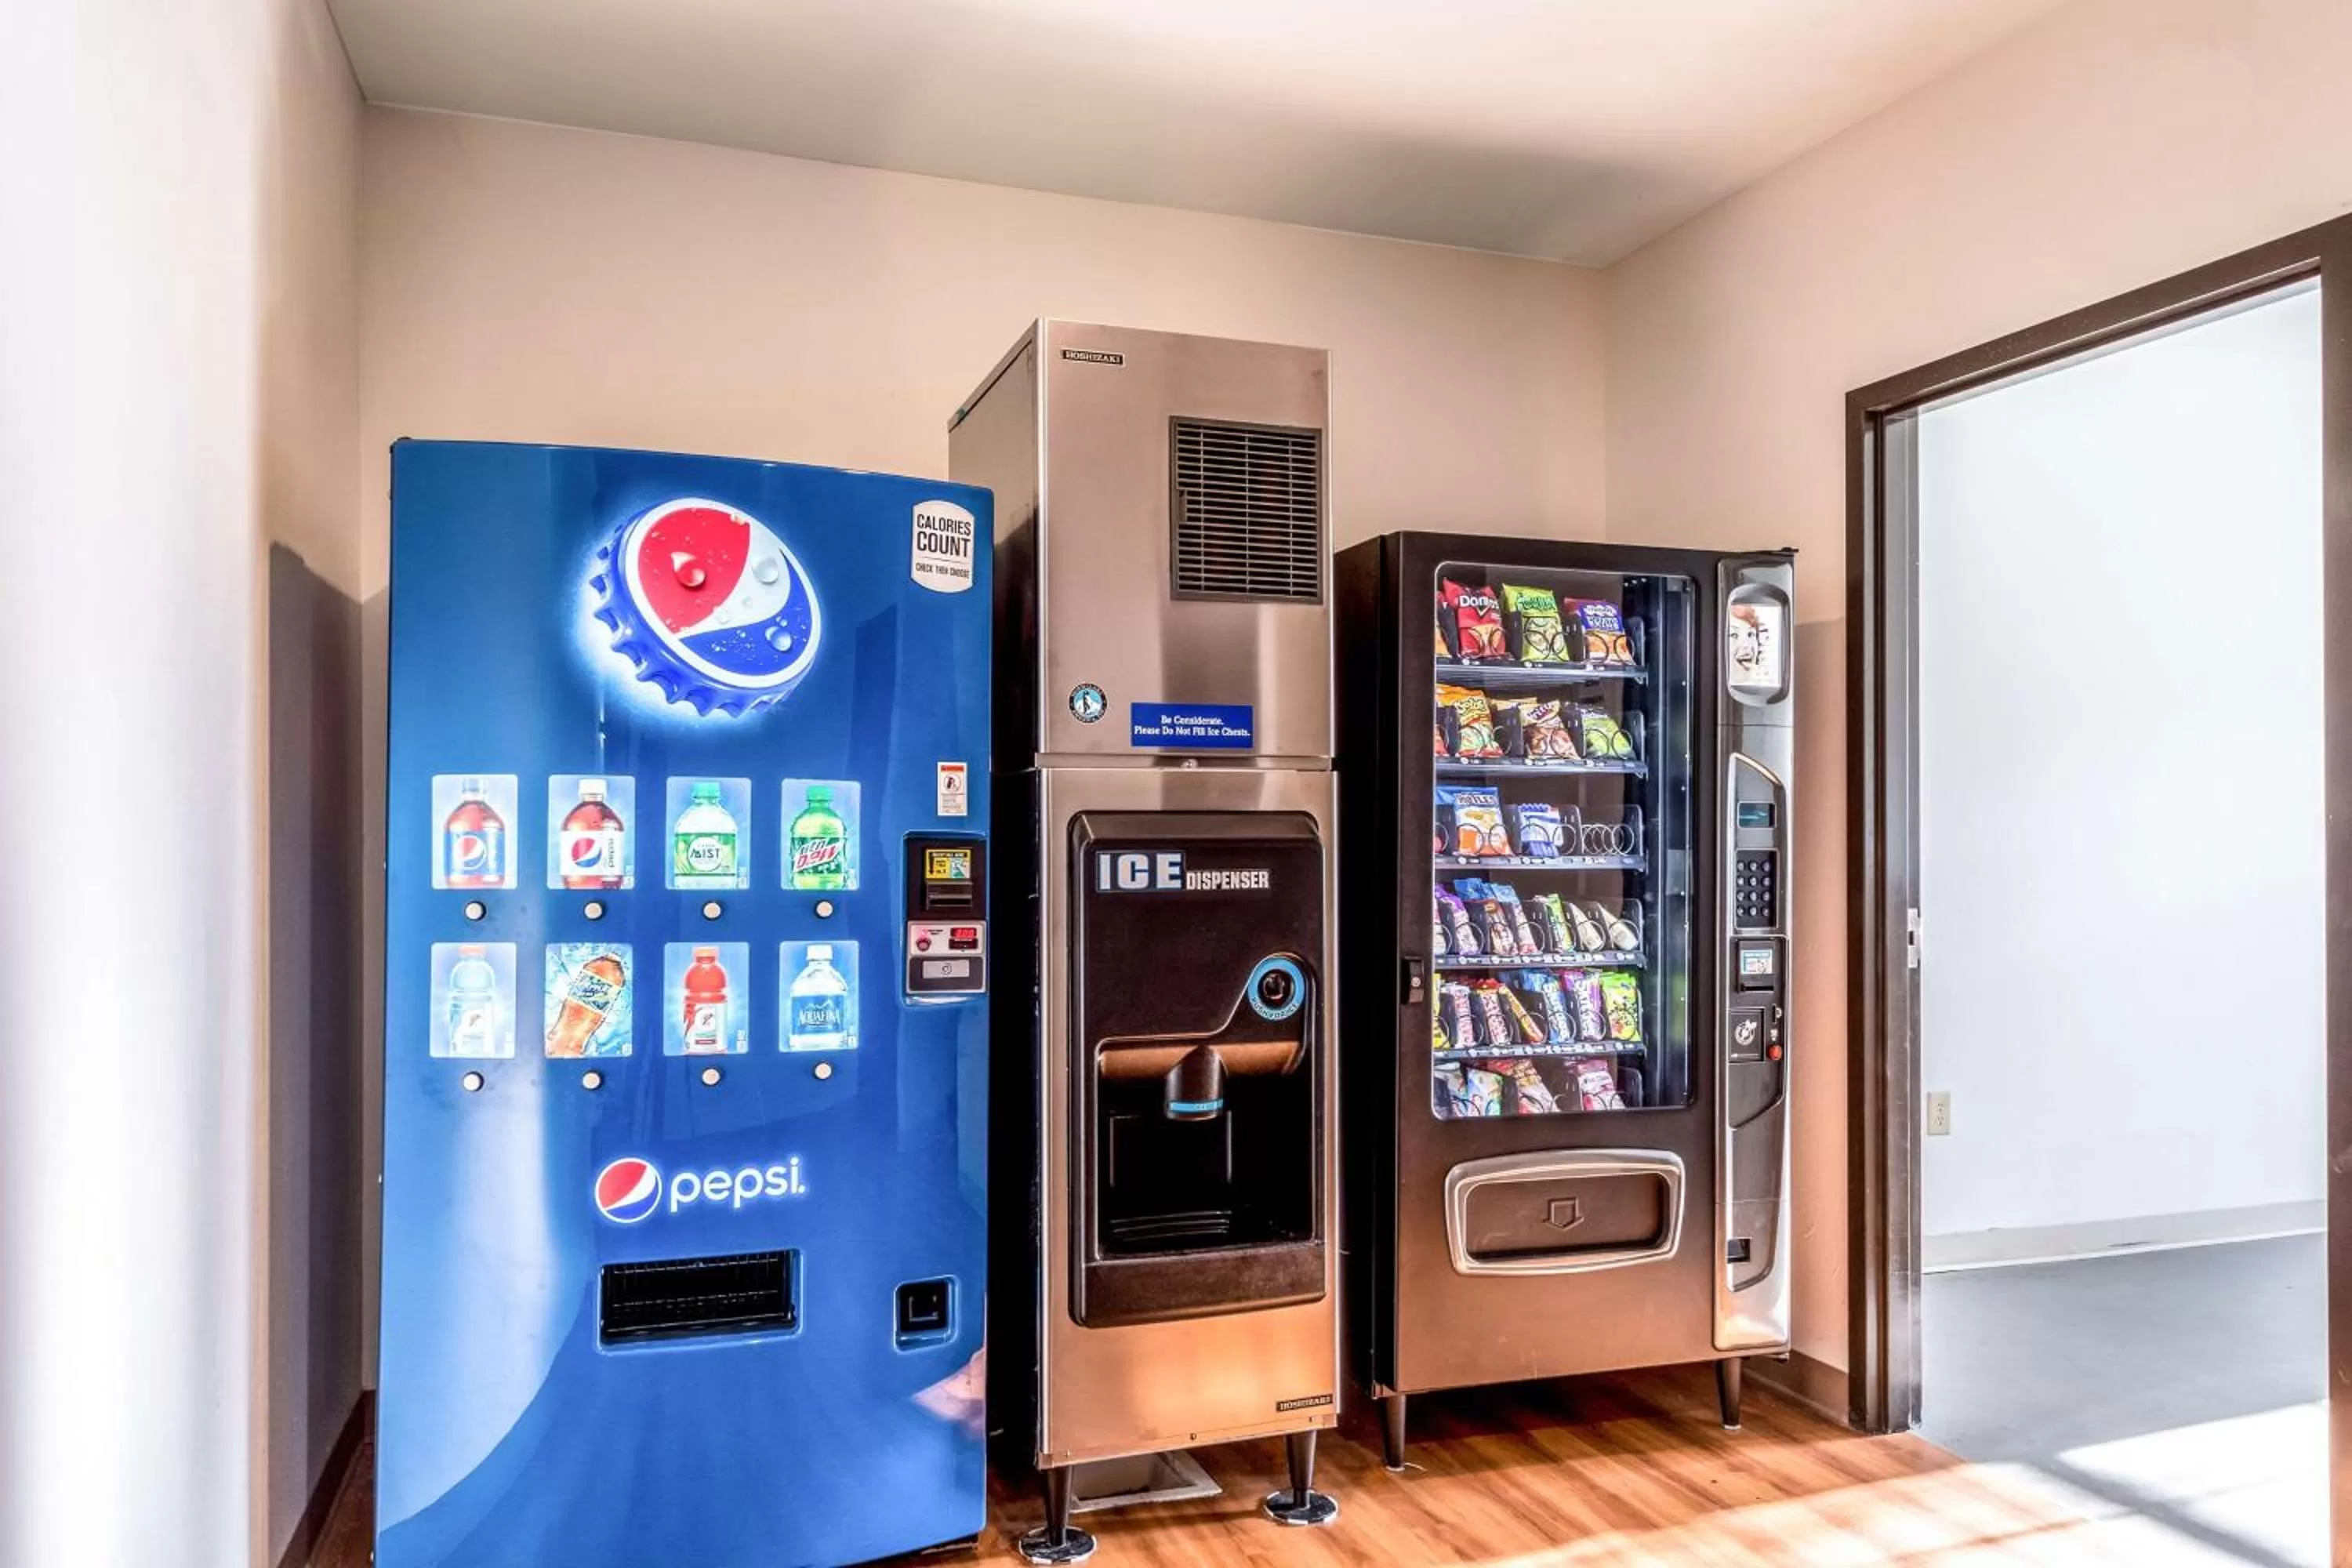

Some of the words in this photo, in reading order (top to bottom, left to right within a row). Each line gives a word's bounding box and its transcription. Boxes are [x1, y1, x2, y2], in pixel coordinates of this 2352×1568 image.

[1065, 350, 1120, 363] HOSHIZAKI
[916, 514, 971, 536] CALORIES
[916, 531, 971, 557] COUNT
[1161, 714, 1172, 724] Be
[1134, 725, 1160, 735] Please
[1162, 726, 1174, 735] Do
[1175, 726, 1191, 735] Not
[1192, 727, 1206, 736] Fill
[1099, 853, 1182, 891] ICE
[1185, 871, 1270, 891] DISPENSER
